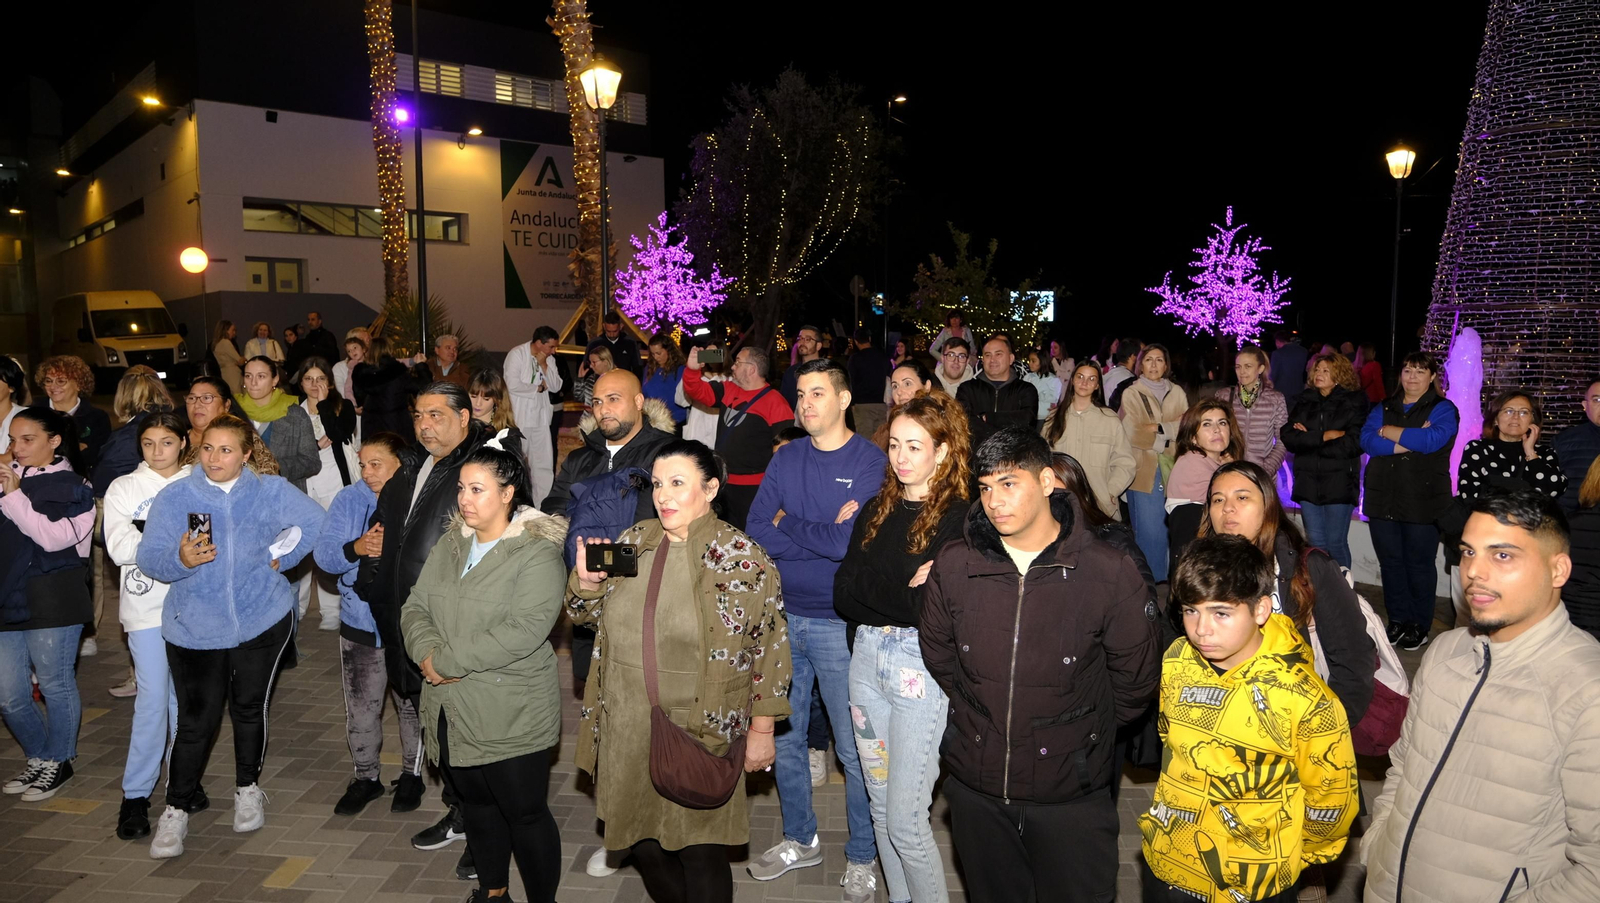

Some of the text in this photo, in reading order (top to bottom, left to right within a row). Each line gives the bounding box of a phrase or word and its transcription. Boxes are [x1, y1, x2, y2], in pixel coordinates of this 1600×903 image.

[516, 188, 578, 200] Junta de Andaluc
[510, 209, 580, 229] Andalucí
[511, 230, 579, 250] TE CUID
[1179, 686, 1227, 706] POW!!!
